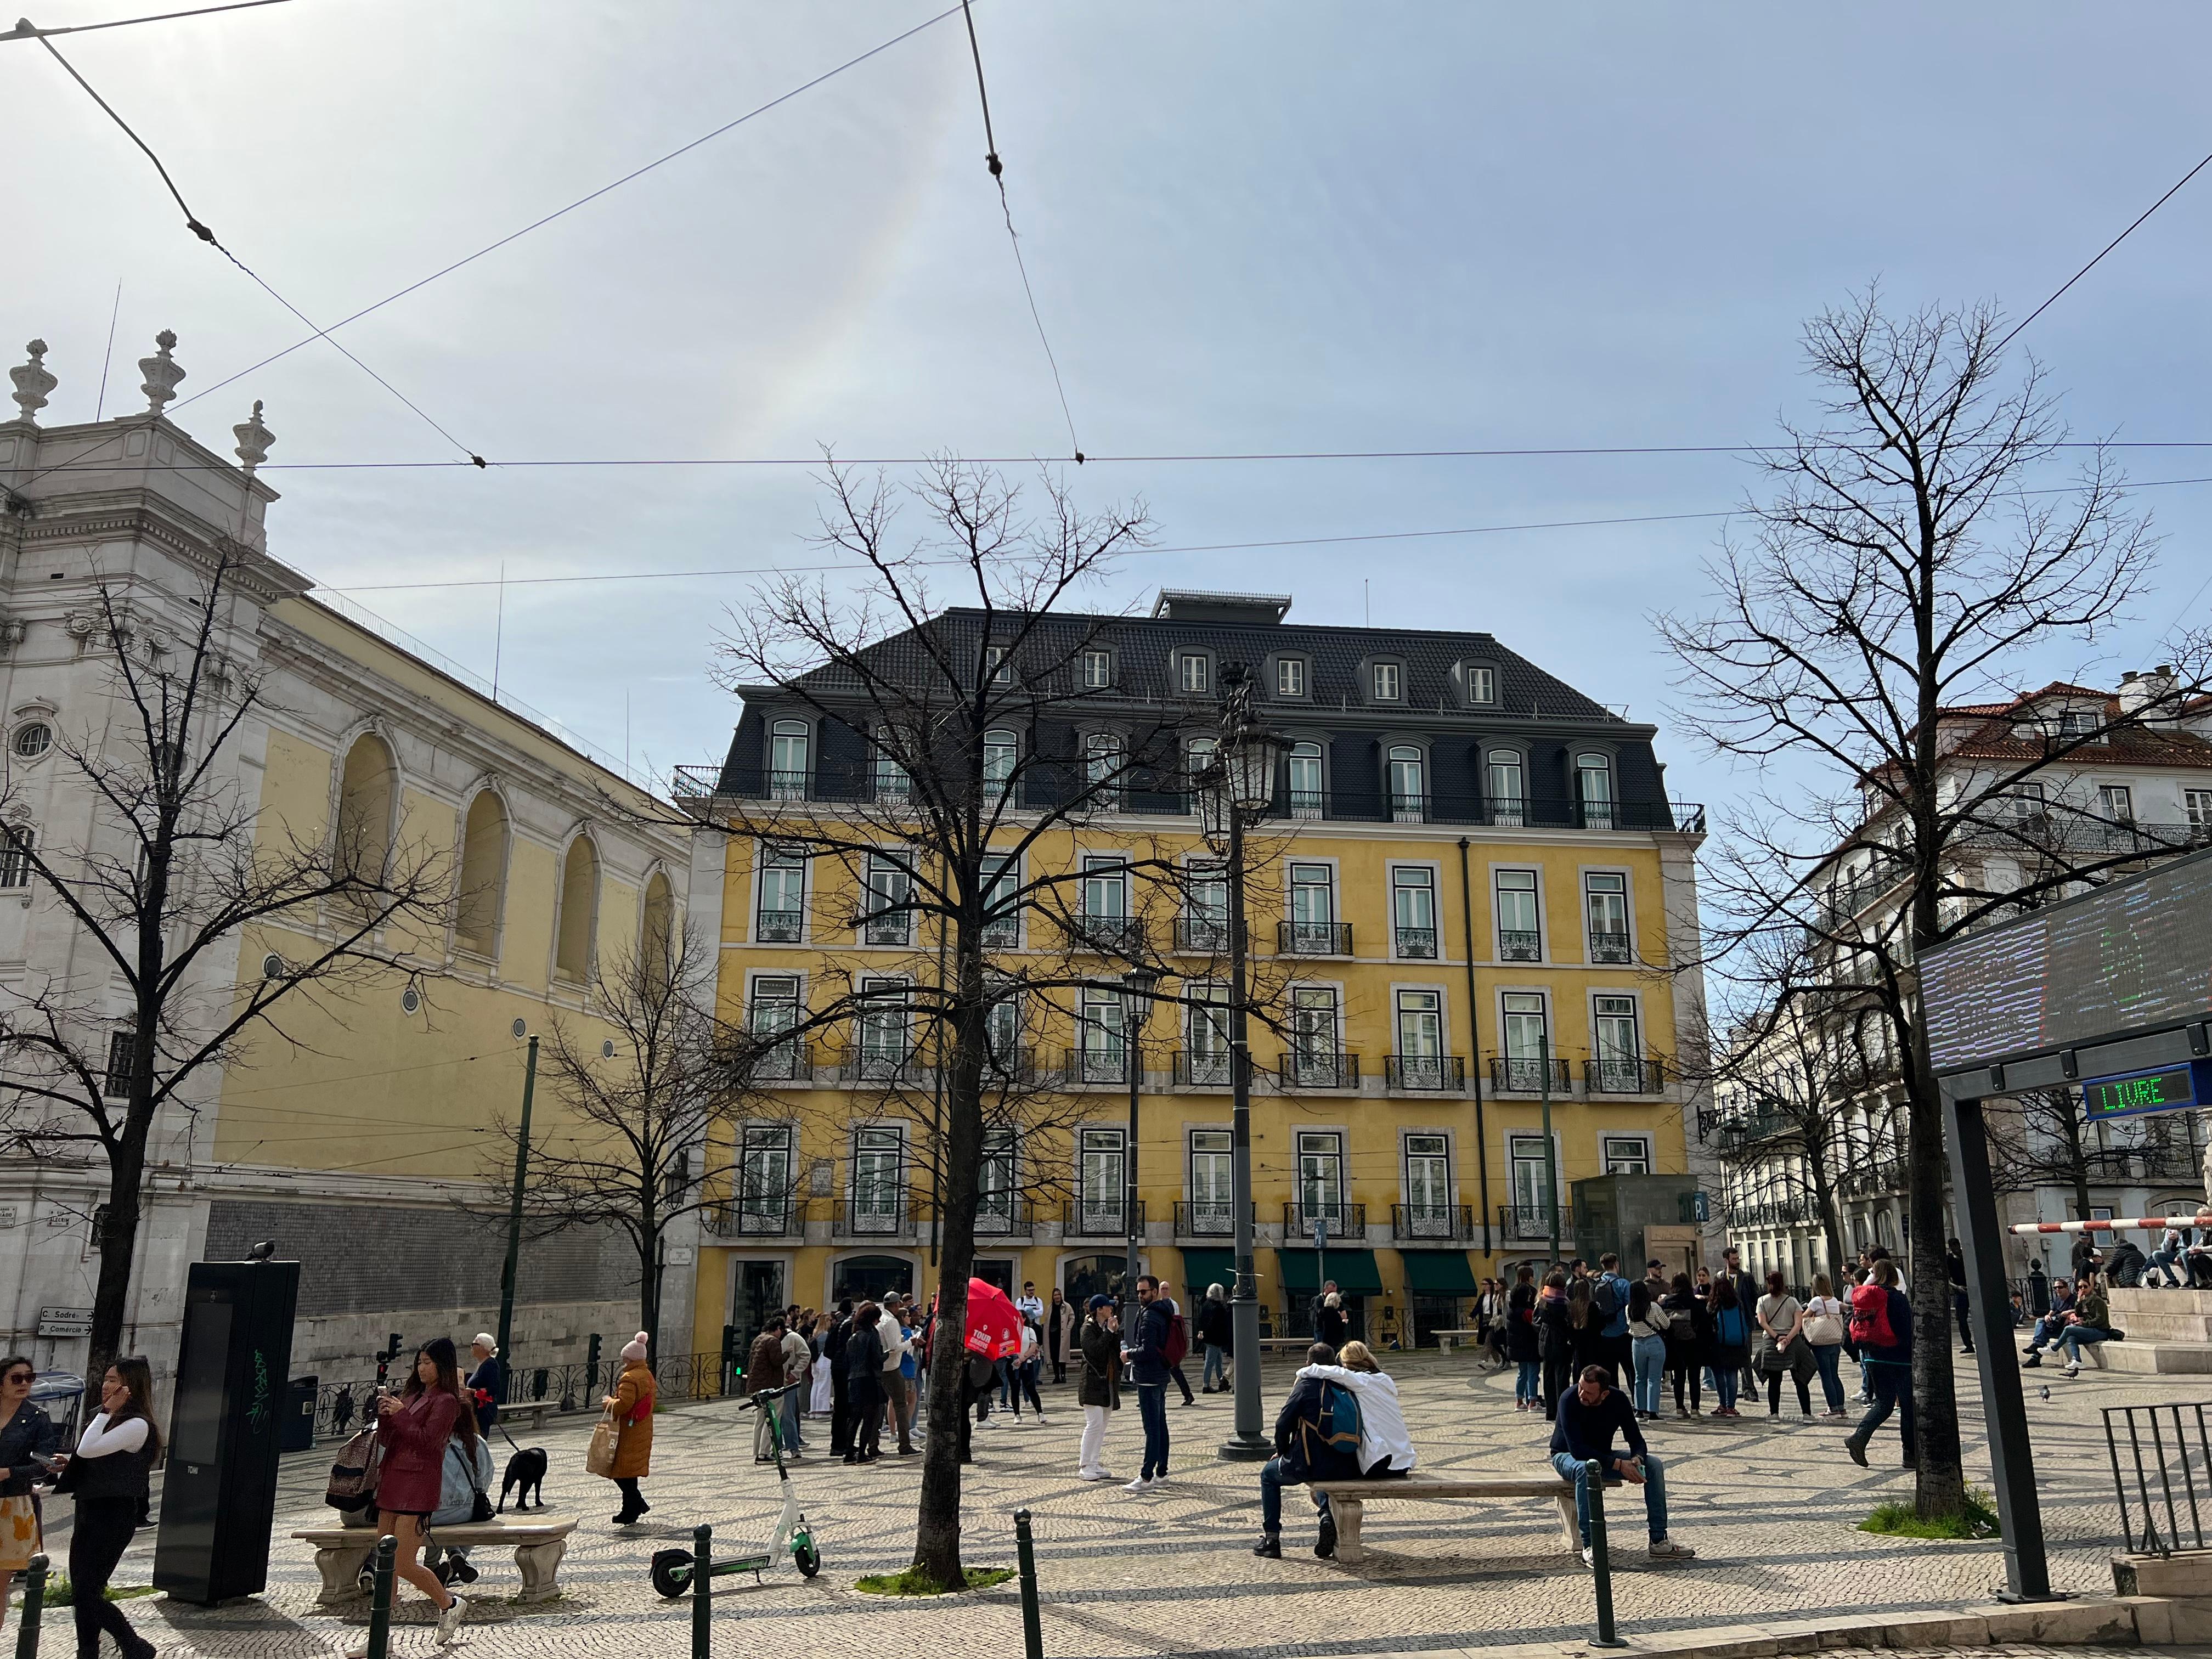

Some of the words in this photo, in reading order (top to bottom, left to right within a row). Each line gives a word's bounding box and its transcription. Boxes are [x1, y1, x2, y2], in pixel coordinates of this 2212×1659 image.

[2101, 1077, 2165, 1110] LIVRE
[973, 1329, 991, 1344] TOUR
[188, 1465, 198, 1475] TOMI
